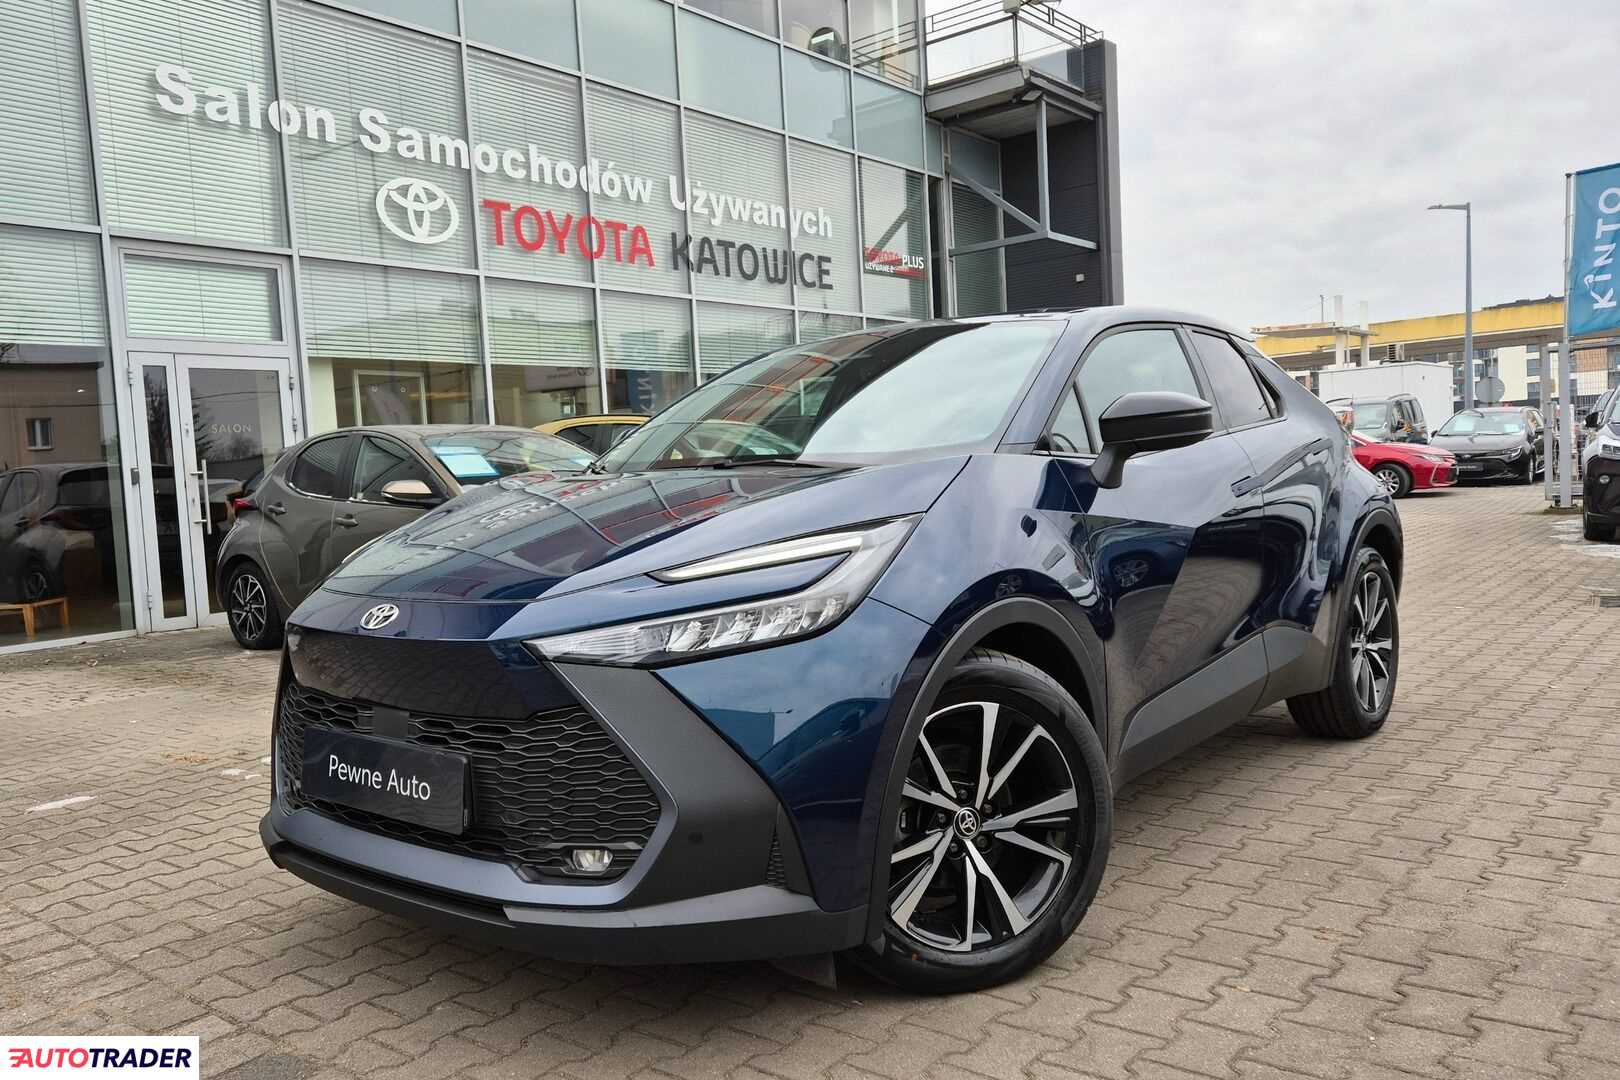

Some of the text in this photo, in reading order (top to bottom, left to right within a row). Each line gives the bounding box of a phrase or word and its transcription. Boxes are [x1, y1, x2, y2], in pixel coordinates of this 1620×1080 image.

[155, 63, 834, 239] Salon Samochodów Używanych
[483, 199, 834, 290] TOYOTA KATOWICE
[902, 254, 925, 269] PLUS
[211, 423, 252, 434] SALON
[328, 754, 431, 801] Pewne Auto
